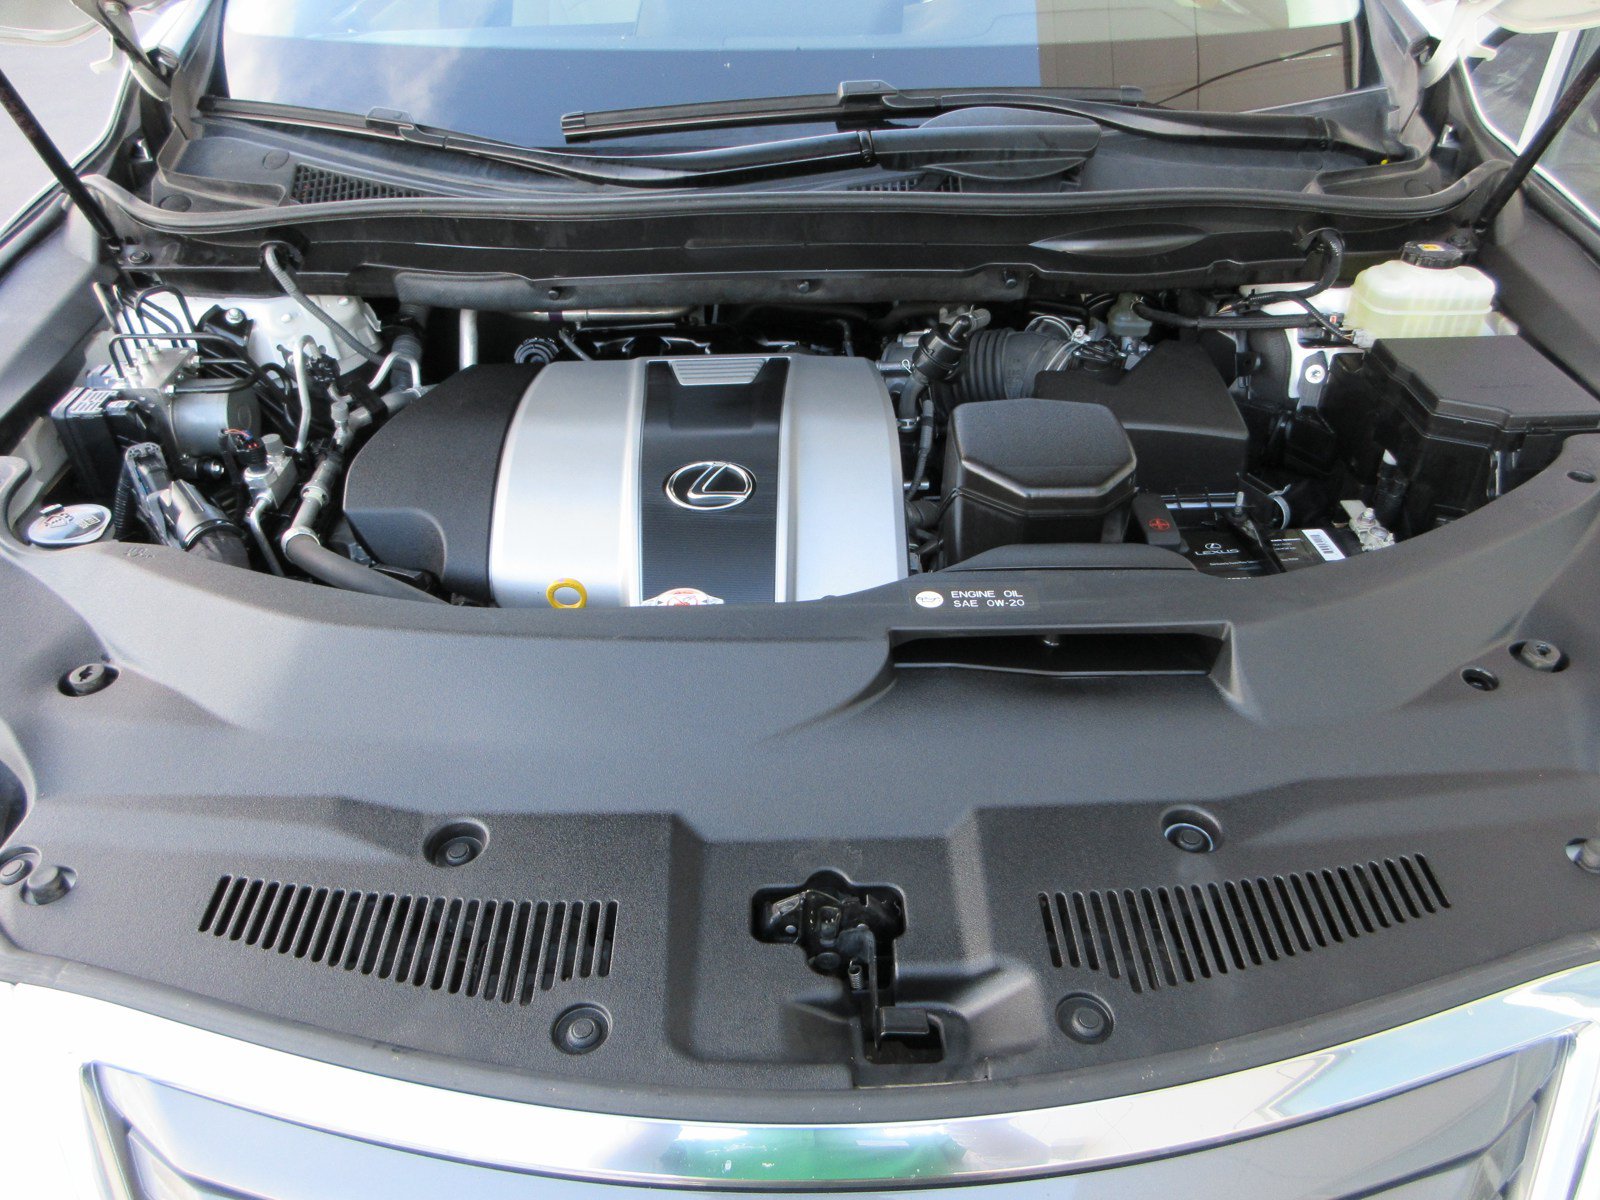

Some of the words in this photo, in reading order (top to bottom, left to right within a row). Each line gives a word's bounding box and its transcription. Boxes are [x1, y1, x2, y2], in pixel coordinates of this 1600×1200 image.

[1194, 548, 1240, 556] LEXUS
[950, 590, 996, 599] ENGINE
[1003, 590, 1024, 598] OIL
[953, 599, 979, 608] SAE
[986, 599, 1025, 607] 0W-20
